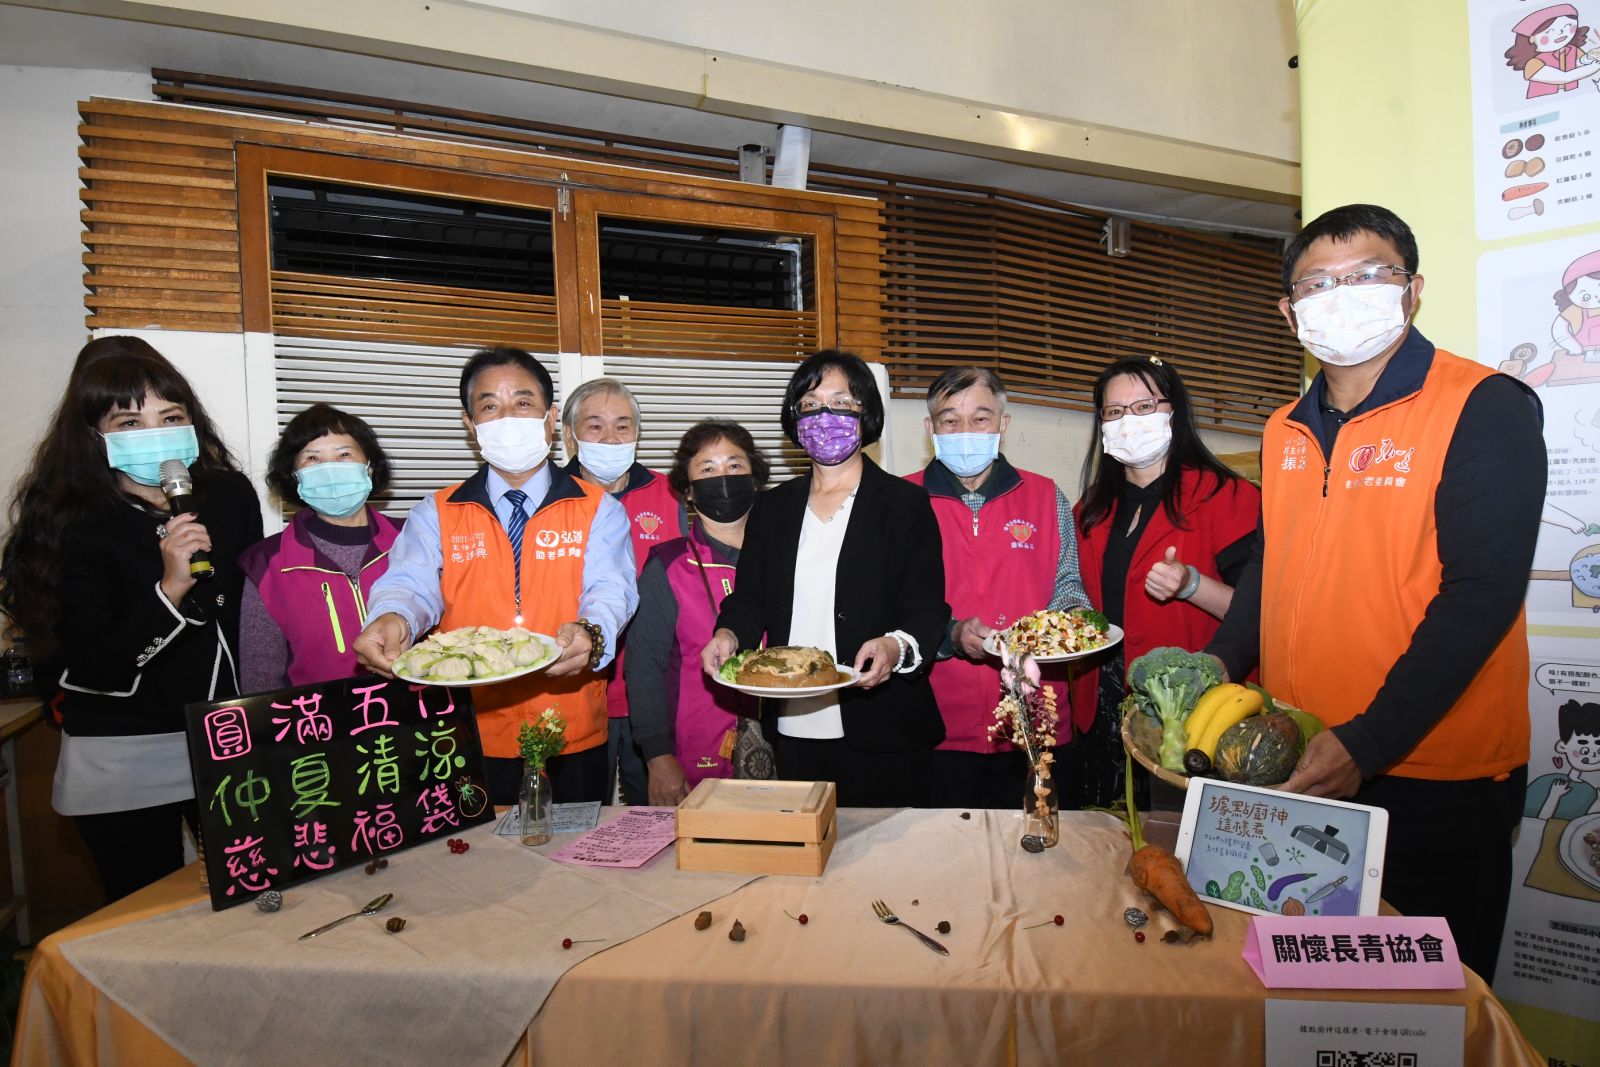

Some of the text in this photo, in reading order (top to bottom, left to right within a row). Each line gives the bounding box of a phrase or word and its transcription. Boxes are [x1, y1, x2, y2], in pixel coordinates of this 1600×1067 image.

[209, 720, 466, 826] 仲夏清涼
[1208, 794, 1289, 826] 據點廚神
[224, 783, 460, 896] 慈悲福袋
[1215, 818, 1268, 840] 這樣煮
[1271, 933, 1445, 964] 關懷長青協會
